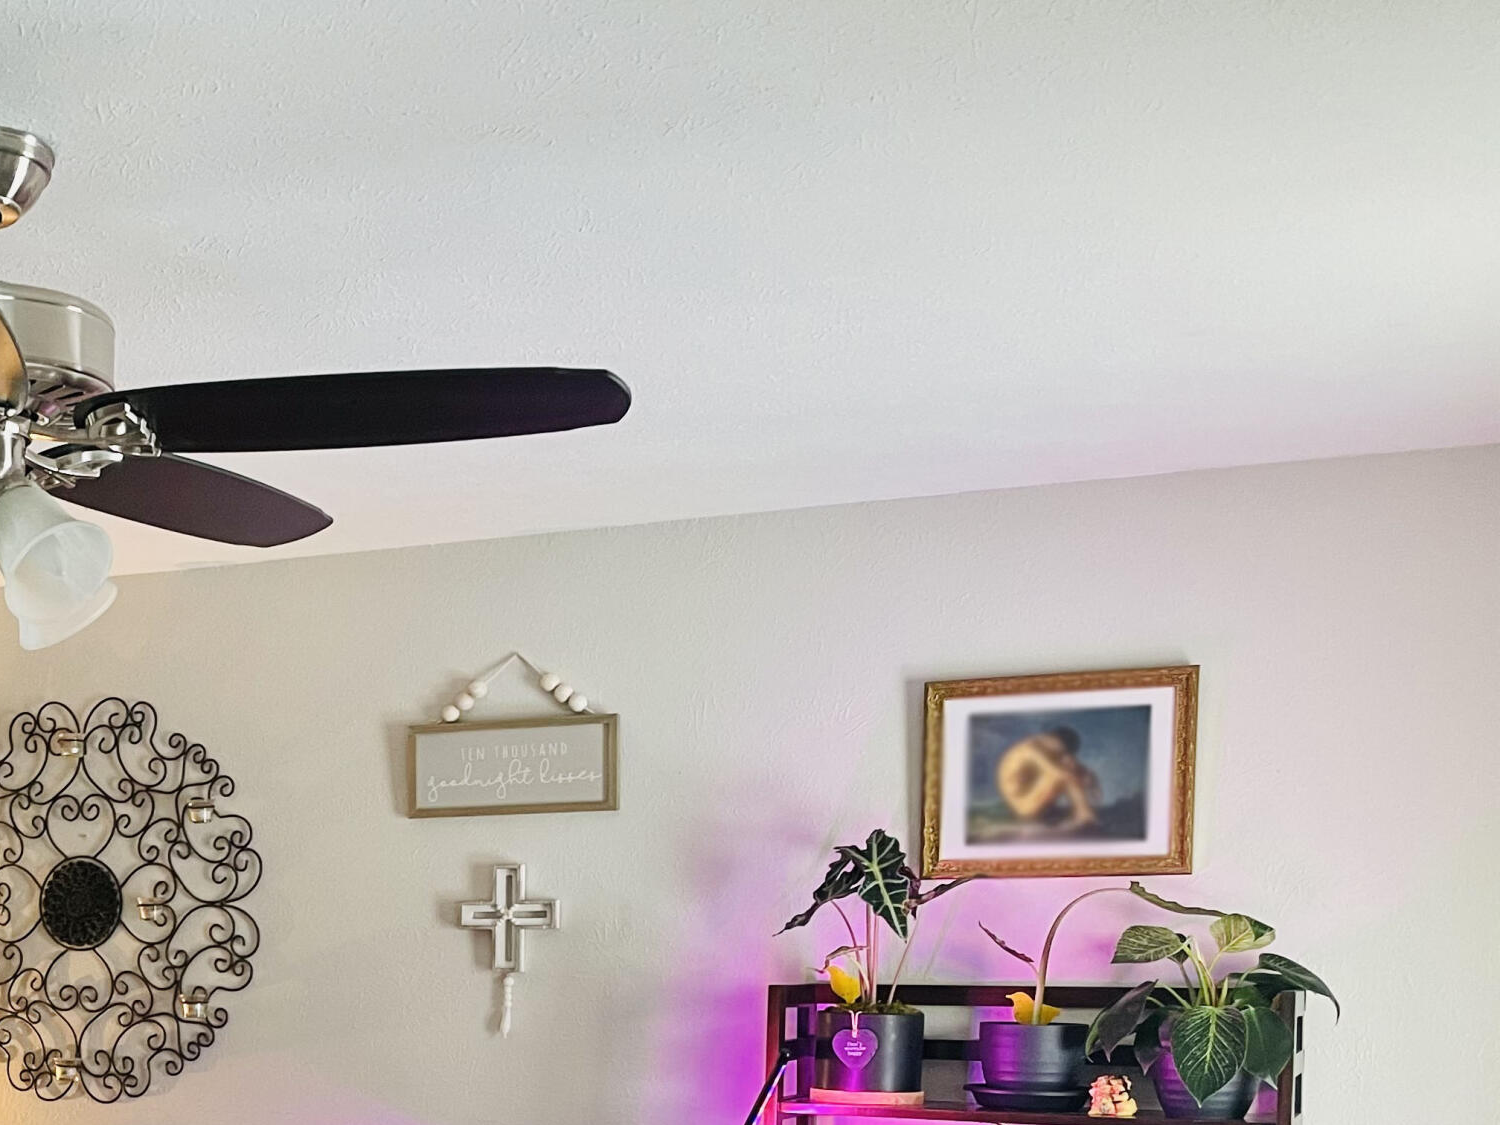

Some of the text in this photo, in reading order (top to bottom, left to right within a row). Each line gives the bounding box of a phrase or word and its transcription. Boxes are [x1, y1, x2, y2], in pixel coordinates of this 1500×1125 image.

[460, 743, 568, 762] TEN THOUSAND
[427, 758, 603, 802] goodnight kisses
